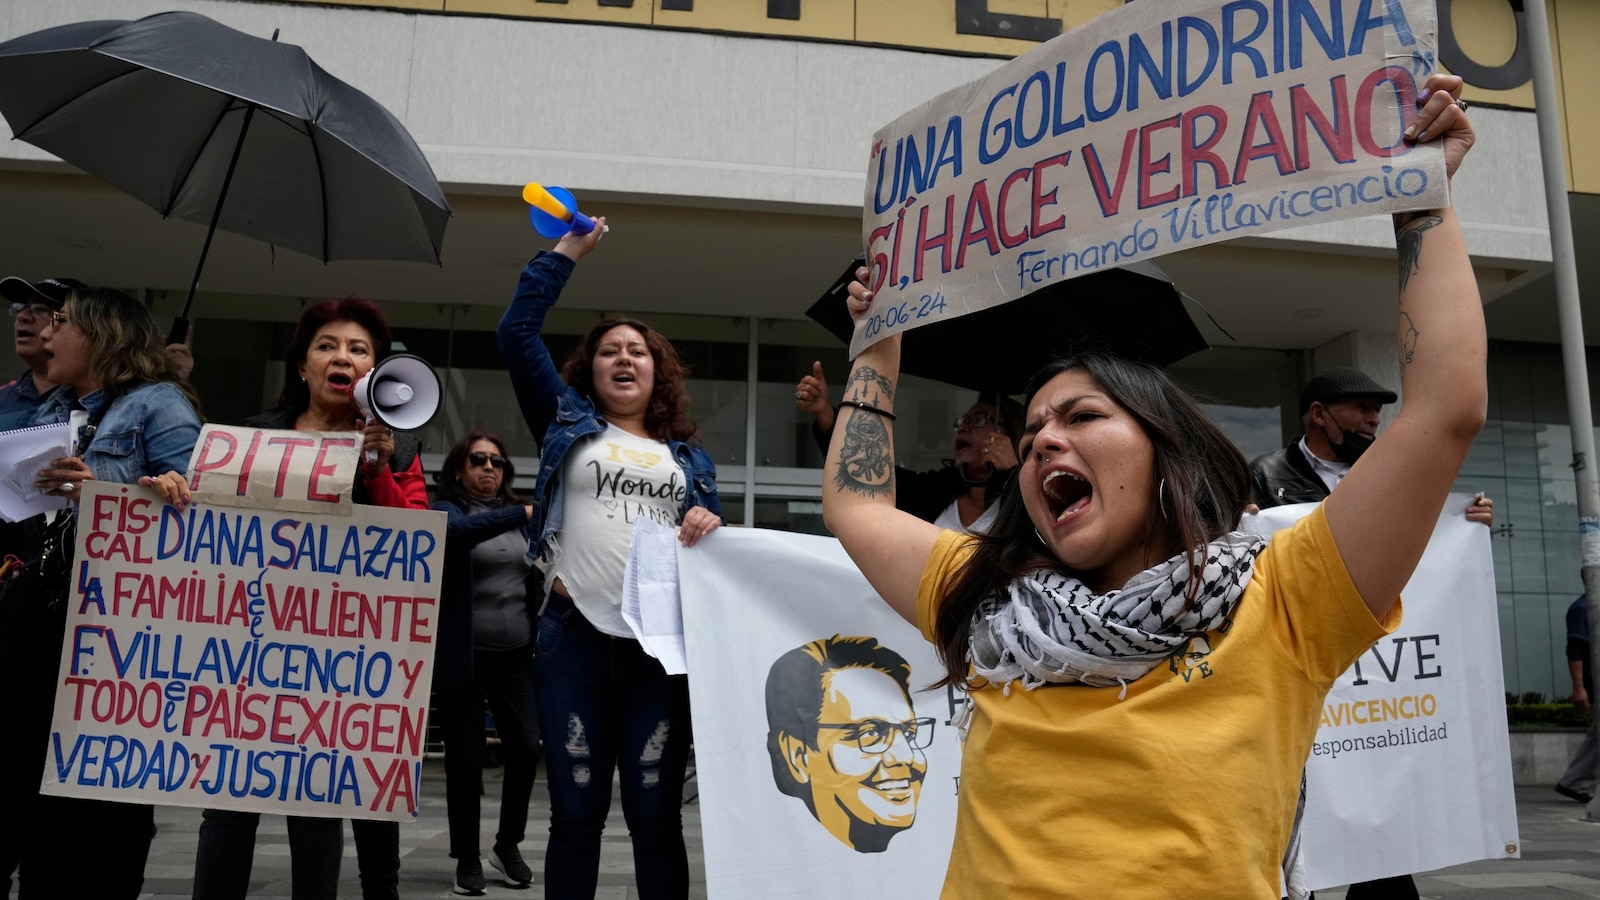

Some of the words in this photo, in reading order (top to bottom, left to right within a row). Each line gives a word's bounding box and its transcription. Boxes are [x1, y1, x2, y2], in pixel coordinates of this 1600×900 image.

[978, 0, 1416, 165] GOLONDRINA
[913, 150, 1072, 283] HACE
[1017, 219, 1159, 290] Fernando
[1162, 165, 1429, 243] Villavicencio
[865, 291, 947, 339] 20-06-24
[189, 430, 356, 503] PITE
[586, 459, 685, 502] Wonde
[606, 442, 623, 463] I
[85, 531, 153, 564] CAL
[157, 502, 264, 568] DIANA
[267, 518, 436, 583] SALAZAR
[77, 560, 107, 615] LA
[112, 569, 250, 627] FAMILIA
[265, 581, 436, 643] VALIENTE
[105, 624, 393, 698] VILLAVICENCIO
[65, 677, 162, 728] TODO
[182, 675, 271, 740] PAÍS
[270, 691, 425, 756] EXIGEN
[1313, 722, 1448, 758] esponsabilidad
[52, 732, 190, 792] VERDAD
[199, 744, 362, 806] JUSTICIA
[363, 757, 421, 817] YA!
